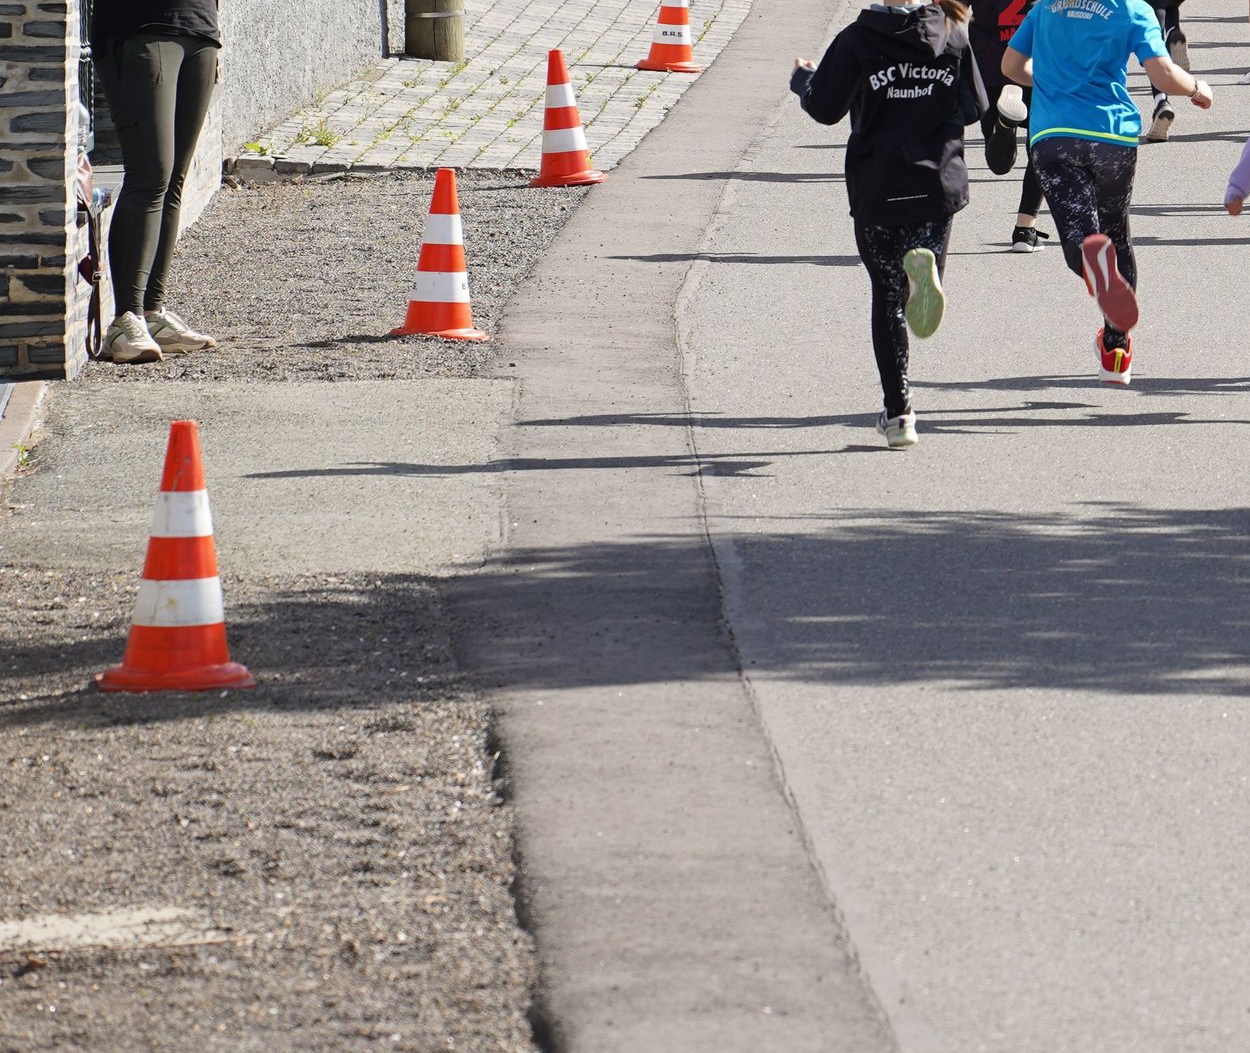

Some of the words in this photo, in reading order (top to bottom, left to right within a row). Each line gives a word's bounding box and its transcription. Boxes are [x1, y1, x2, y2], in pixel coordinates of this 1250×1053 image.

[869, 66, 896, 91] BSC
[898, 62, 955, 87] Victoria
[886, 83, 935, 100] Naunhof
